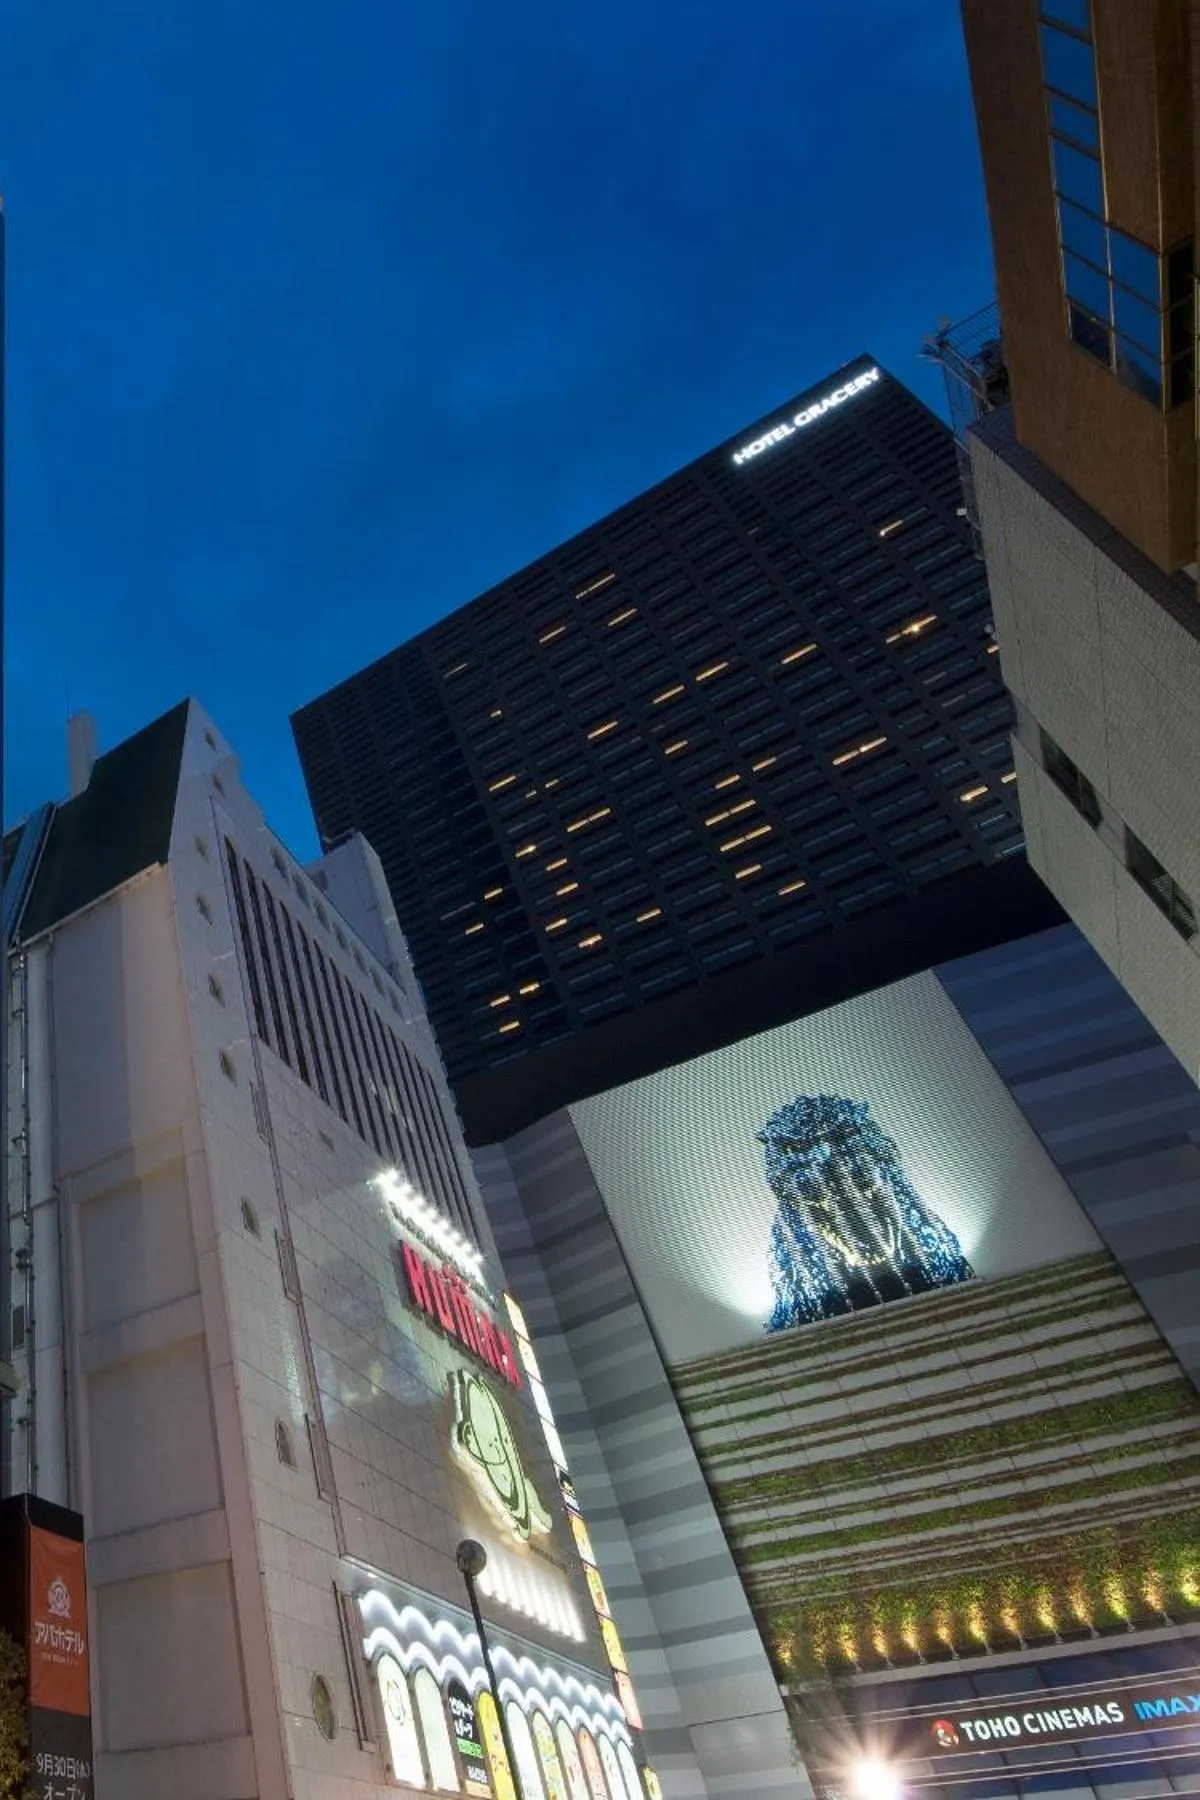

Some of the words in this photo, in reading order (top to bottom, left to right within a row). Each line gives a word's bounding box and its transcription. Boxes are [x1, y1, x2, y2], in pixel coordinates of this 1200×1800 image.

[733, 423, 796, 464] HOTEL
[794, 367, 880, 427] GRACERY
[35, 1621, 85, 1655] アパホテル
[960, 1715, 1022, 1742] TOHO
[1023, 1702, 1125, 1735] CINEMAS
